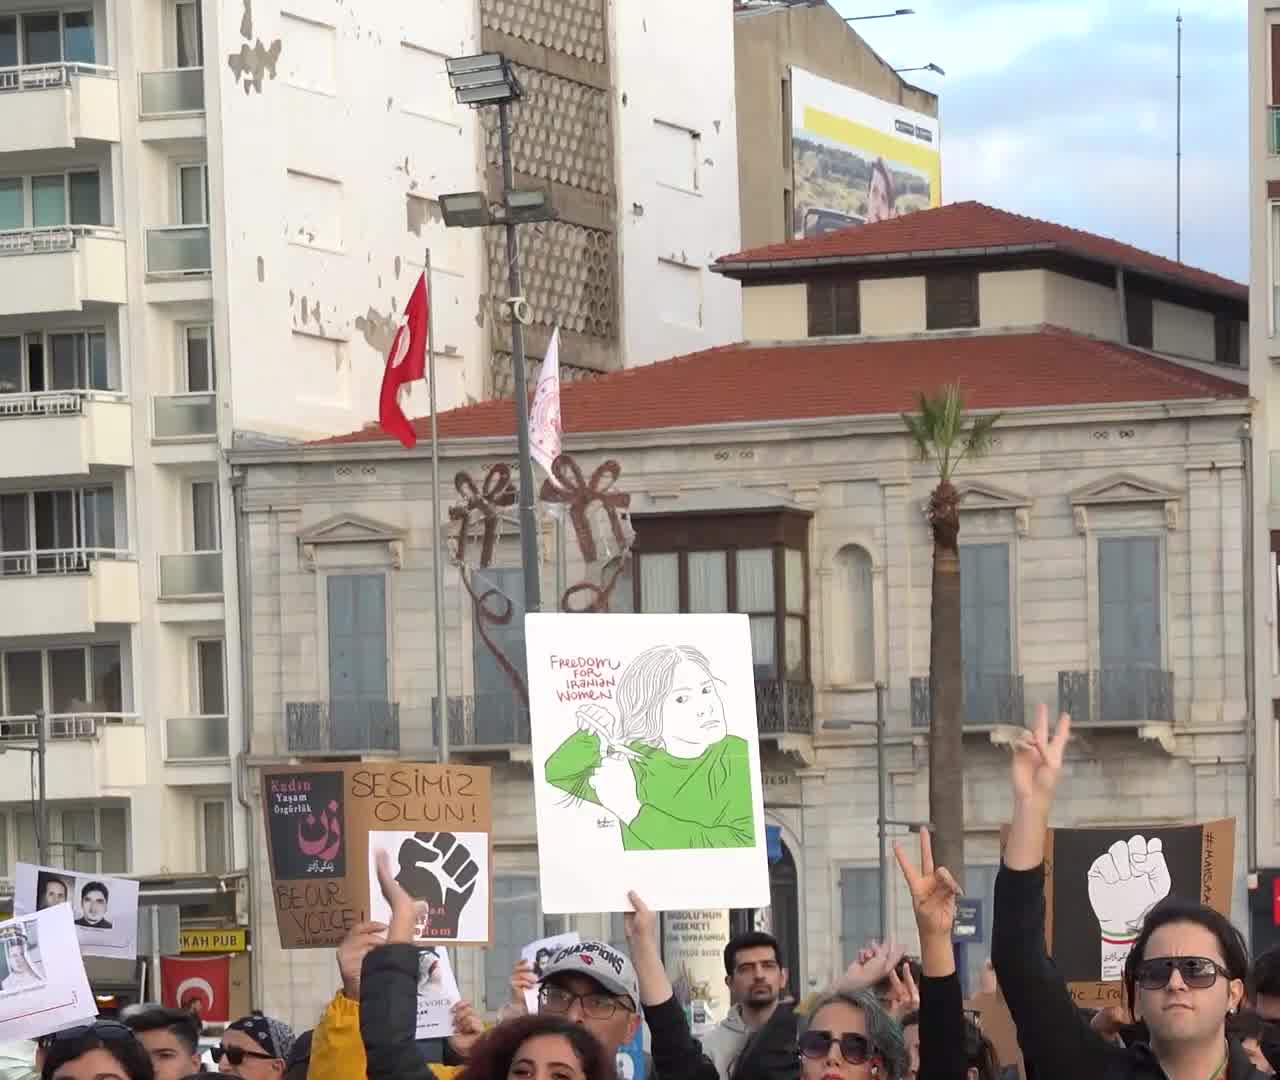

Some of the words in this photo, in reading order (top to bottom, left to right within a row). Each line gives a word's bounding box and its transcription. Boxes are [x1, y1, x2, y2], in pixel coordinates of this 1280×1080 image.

[374, 801, 477, 823] OLUN!
[277, 885, 304, 911] BE
[304, 882, 347, 907] OUR
[213, 935, 238, 946] PUB
[554, 942, 625, 976] CHAMPIONS
[1095, 983, 1122, 1001] Ira
